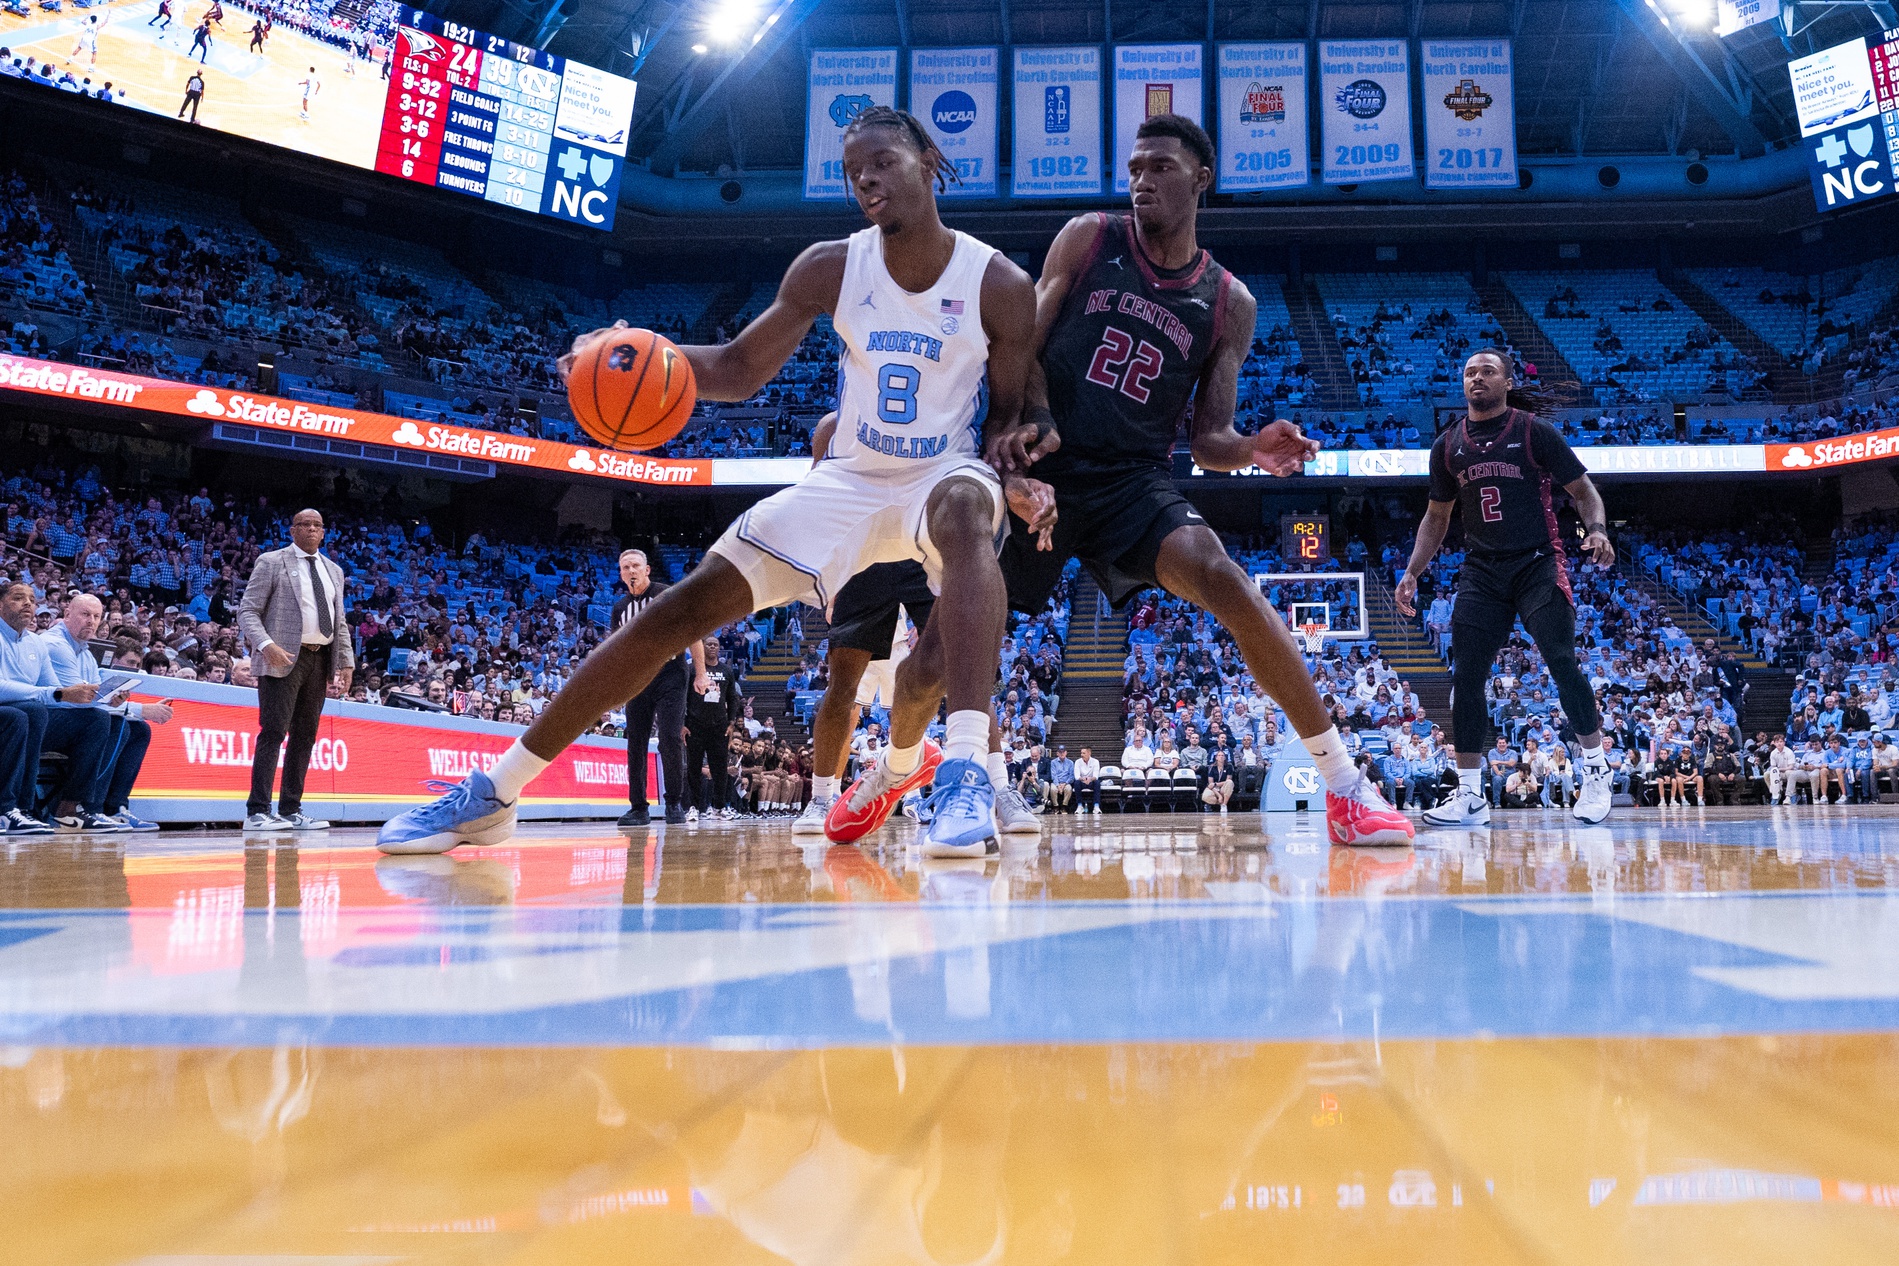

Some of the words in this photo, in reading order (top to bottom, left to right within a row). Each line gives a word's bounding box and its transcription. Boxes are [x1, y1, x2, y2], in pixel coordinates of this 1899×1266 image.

[1737, 2, 1760, 18] 2009
[443, 21, 475, 45] 19:21
[515, 45, 530, 63] 12
[1873, 48, 1880, 60] 1
[403, 57, 421, 73] FLS:
[421, 63, 429, 75] 0
[449, 43, 478, 75] 24
[486, 55, 513, 86] 39
[1874, 60, 1884, 73] 2
[446, 70, 464, 86] TOL:
[464, 76, 471, 88] 2
[1797, 79, 1821, 92] Nice
[1823, 75, 1835, 84] to
[1877, 73, 1885, 86] 7
[402, 72, 442, 99] 9-32
[451, 89, 474, 106] FIELD
[474, 96, 500, 114] GOALS
[505, 104, 548, 130] 14-25
[565, 85, 587, 98] Nice
[590, 93, 600, 103] to
[1248, 92, 1284, 103] FINAL
[1354, 89, 1380, 98] FINAL
[1449, 97, 1468, 105] FINAL
[1799, 86, 1828, 102] meet
[1830, 80, 1855, 95] you.
[1879, 86, 1890, 99] 11
[563, 96, 590, 110] meet
[1345, 95, 1380, 109] FOUR
[1879, 99, 1895, 112] 22
[399, 93, 437, 119] 3-12
[451, 111, 457, 123] 3
[458, 112, 482, 129] POINT
[482, 120, 494, 133] FG
[507, 125, 539, 148] 3-11
[936, 111, 976, 122] NCAA
[1885, 112, 1894, 125] 0
[1887, 125, 1897, 137] 8
[400, 115, 430, 138] 3-6
[443, 131, 462, 146] FREE
[463, 136, 494, 155] THROWS
[503, 145, 538, 168] 8-10
[402, 138, 422, 158] 14
[444, 152, 486, 174] REBOUNDS
[506, 167, 527, 187] 24
[1234, 149, 1291, 172] 2005
[1335, 143, 1400, 165] 2009
[1439, 148, 1503, 168] 2017
[821, 160, 845, 180] 19
[1028, 155, 1088, 177] 1982
[1325, 169, 1361, 178] NATIONAL
[1364, 165, 1411, 176] CHAMPIONS
[401, 159, 415, 177] 6
[439, 171, 486, 195] TURNOVERS
[505, 187, 523, 206] 10
[1017, 182, 1051, 190] NATIONAL
[1221, 174, 1259, 184] NATIONAL
[1260, 171, 1305, 183] CHAMPIONS
[1429, 173, 1464, 181] NATIONAL
[1822, 160, 1884, 205] NC
[551, 181, 609, 224] NC
[1085, 290, 1117, 315] NC
[1118, 292, 1193, 361] CENTRAL
[866, 331, 943, 362] NORTH
[1085, 325, 1164, 404] 22
[877, 362, 921, 425] 8
[1314, 451, 1338, 476] 39
[1600, 450, 1742, 469] BASKETBALL
[1467, 461, 1524, 482] CENTRAL
[1480, 486, 1503, 522] 2
[1293, 523, 1323, 535] 19:21
[1301, 536, 1319, 558] 12
[181, 727, 256, 766] WELL
[277, 733, 348, 771] FGO
[428, 748, 479, 776] WELLS
[573, 760, 607, 783] WELLS
[608, 763, 629, 784] FAR
